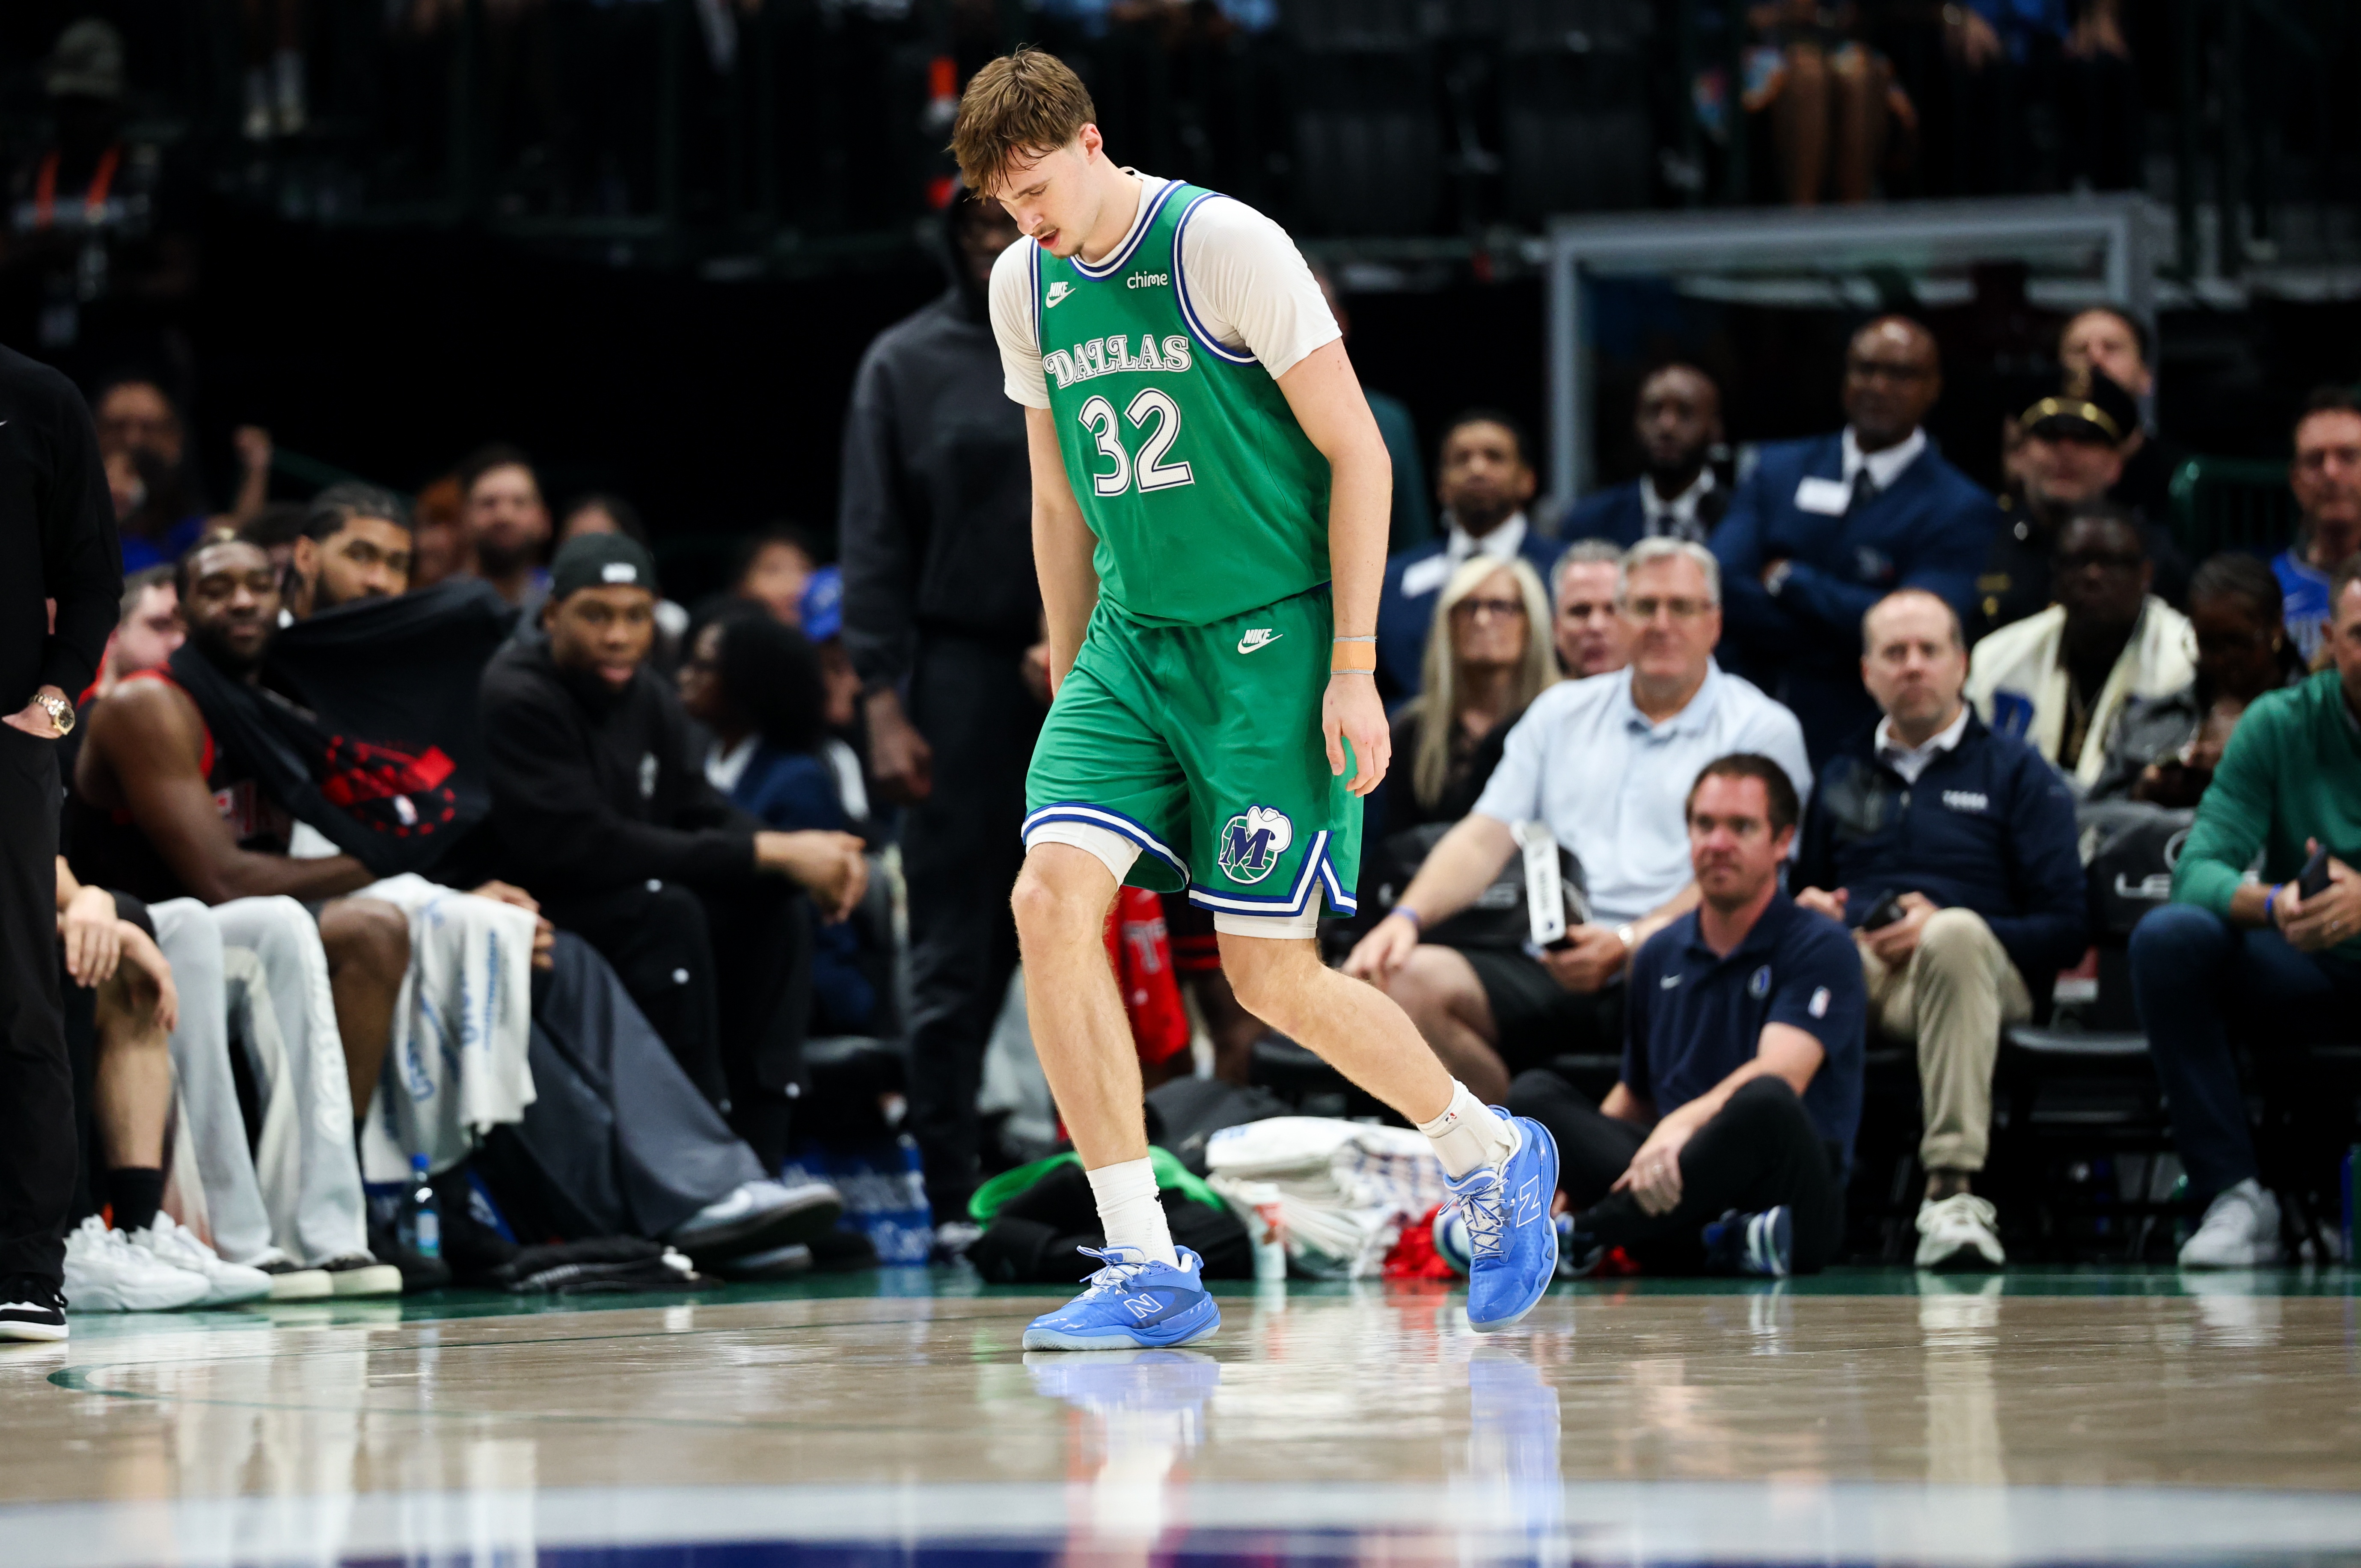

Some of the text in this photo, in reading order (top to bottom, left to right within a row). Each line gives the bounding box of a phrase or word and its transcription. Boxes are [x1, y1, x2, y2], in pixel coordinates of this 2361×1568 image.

[1049, 281, 1069, 297] NIKE
[1127, 271, 1168, 289] chime
[1042, 334, 1192, 389] DALLAS
[1078, 387, 1195, 496] 32
[1242, 629, 1272, 644] NIKE
[1218, 825, 1277, 870] M
[1123, 1293, 1163, 1319] N
